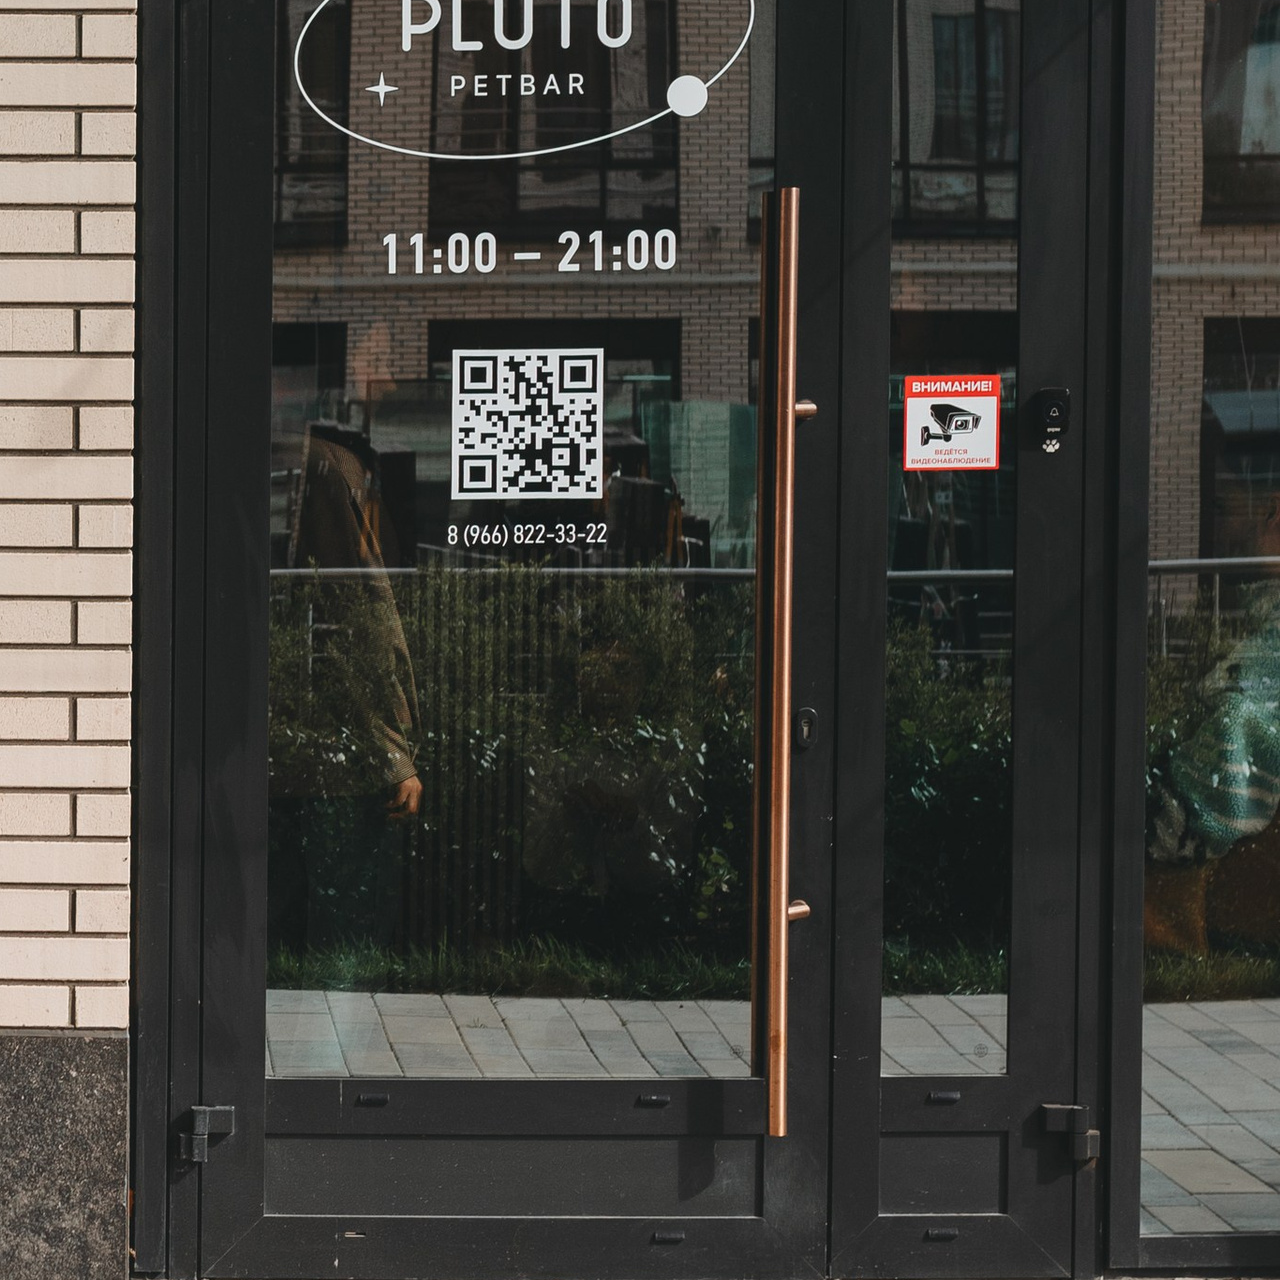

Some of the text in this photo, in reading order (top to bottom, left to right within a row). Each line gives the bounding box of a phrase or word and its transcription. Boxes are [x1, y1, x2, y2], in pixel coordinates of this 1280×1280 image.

[450, 73, 585, 97] PETBAR
[383, 232, 497, 274] 11:00
[558, 228, 676, 272] 21:00
[912, 381, 992, 393] ВНИМАНИЕ!
[447, 523, 607, 547] 8 (966) 822-33-22
